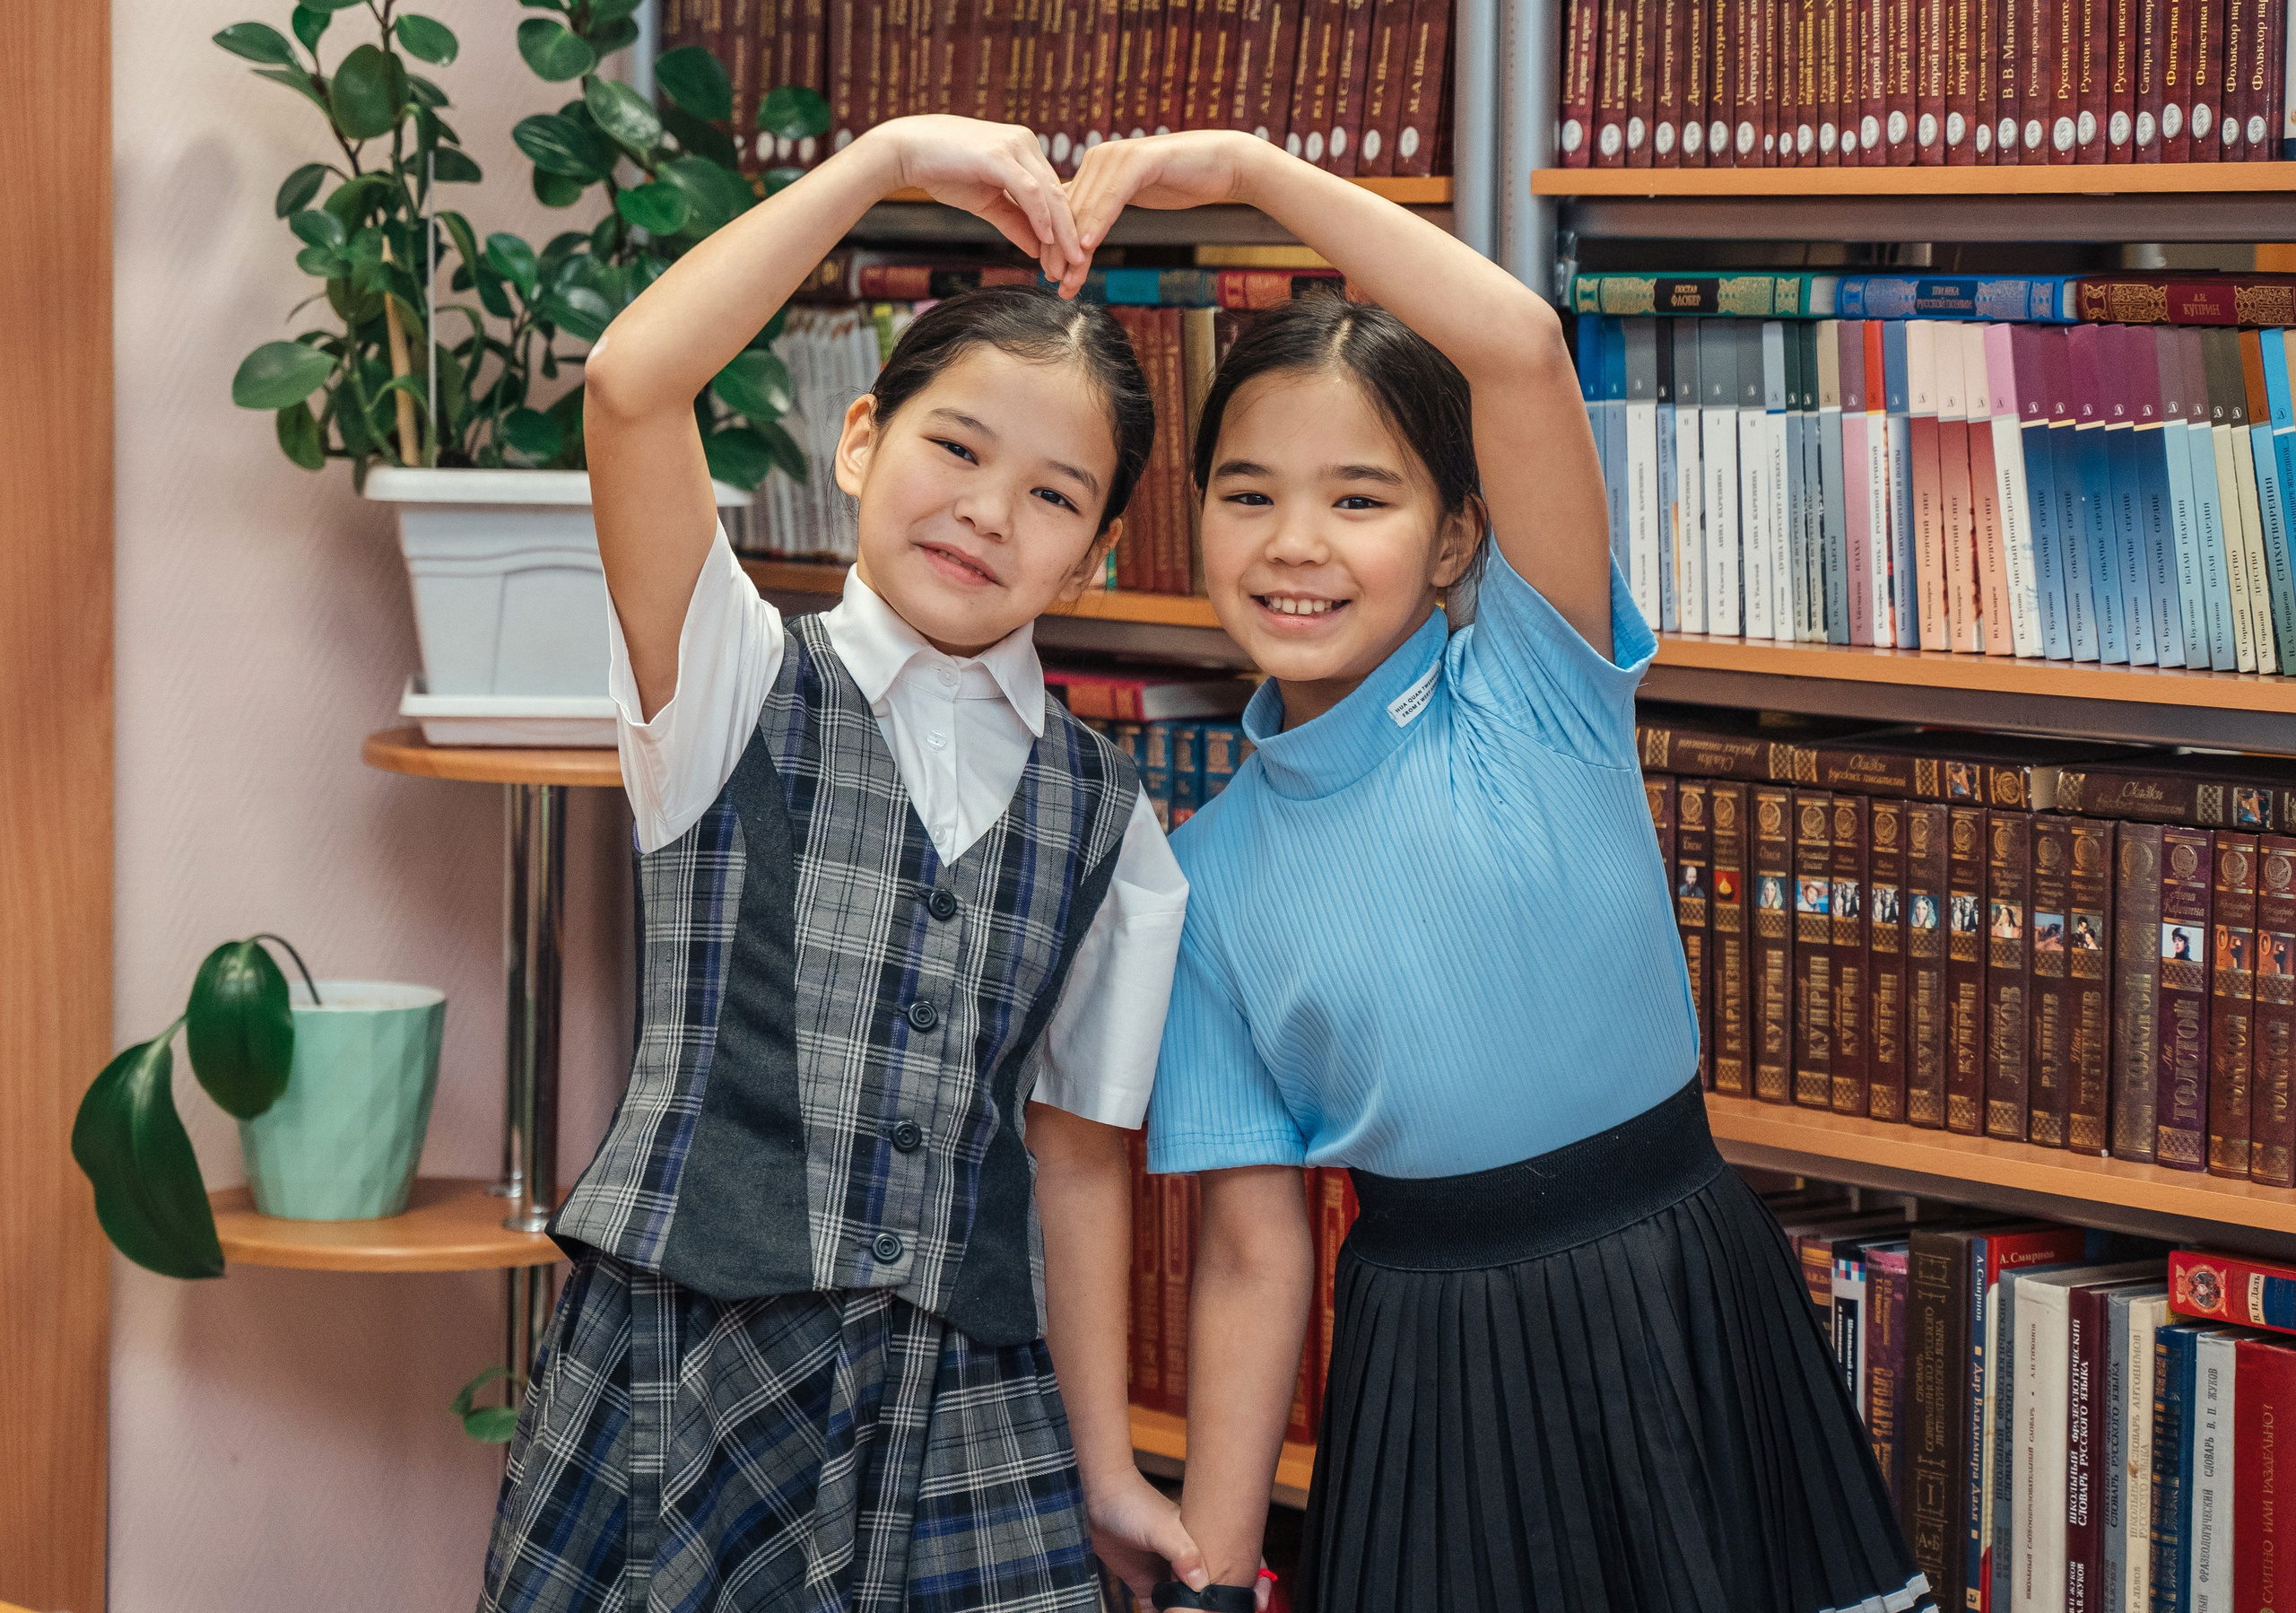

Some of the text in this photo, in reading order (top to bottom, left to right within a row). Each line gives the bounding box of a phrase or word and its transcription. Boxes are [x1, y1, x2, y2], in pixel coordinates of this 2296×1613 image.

[1583, 6, 1592, 40] прозе
[1617, 10, 1629, 99] лирике прозе
[1688, 8, 1701, 106] Древнерусская
[1746, 16, 1760, 105] Литературные
[1861, 11, 1869, 47] проза
[1918, 7, 1928, 97] Русская проза
[1948, 5, 1956, 41] проза
[2028, 26, 2040, 97] Русская проза
[2166, 6, 2179, 86] Фантастика
[2196, 5, 2208, 86] Фантастика
[2226, 23, 2241, 92] Фольклор
[2252, 22, 2267, 91] Фольклор
[1601, 33, 1613, 109] Гражданская
[1631, 24, 1645, 102] Драматургия
[1660, 28, 1674, 107] Драматургия
[1714, 25, 1726, 105] Литература
[1765, 57, 1774, 100] Русская
[1782, 67, 1791, 106] Русская
[1804, 67, 1814, 104] первой
[1820, 57, 1829, 102] Русская
[1827, 65, 1838, 102] второй
[1843, 55, 1855, 103] Русская
[1870, 56, 1883, 99] первой
[1887, 44, 1896, 94] Русская
[1897, 51, 1910, 94] второй
[1928, 53, 1942, 97] второй
[1956, 51, 1970, 95] второй
[1978, 31, 1988, 101] Русская проза
[2002, 63, 2014, 99] В. В.
[2057, 47, 2071, 99] Русские
[2079, 40, 2092, 92] Русские
[2113, 40, 2126, 93] Русские
[2140, 48, 2153, 94] Сатира
[2183, 303, 2221, 317] КУПРИН
[1853, 538, 1861, 571] ПЛАХА
[1896, 490, 1905, 557] СТИХОТВОРЕНИЯ
[1921, 491, 1933, 620] Бондарев ГОРЯЧИЙ СНЕГ
[1950, 495, 1963, 624] Бондарев ГОРЯЧИЙ СНЕГ
[1983, 496, 1999, 625] Бондарев ГОРЯЧИЙ СНЕГ
[2003, 469, 2021, 587] ЧИСТЫЙ ПОНЕДЕЛЬНИК
[2037, 489, 2057, 630] Булгаков СОБАЧЬЕ СЕРДЦЕ
[2064, 490, 2083, 632] Булгаков СОБАЧЬЕ СЕРДЦЕ
[2265, 476, 2293, 632] Некрасов СТИХОТВОРЕНИЯ
[2093, 493, 2114, 634] Булгаков СОБАЧЬЕ СЕРДЦЕ
[2122, 493, 2142, 636] Булгаков СОБАЧЬЕ СЕРДЦЕ
[2151, 494, 2170, 638] Булгаков СОБАЧЬЕ СЕРДЦЕ
[2178, 500, 2196, 639] Булгаков БЕЛАЯ ГВАРДИЯ
[2203, 501, 2222, 641] Булгаков БЕЛАЯ ГВАРДИЯ
[2231, 549, 2248, 644] Горький ДЕТСТВО
[2250, 551, 2268, 646] Горький ДЕТСТВО
[1395, 702, 1408, 714] HUA
[1407, 689, 1423, 704] QUAN
[1402, 704, 1418, 719] FROM
[2122, 780, 2165, 800] Сказки
[2163, 898, 2205, 917] Каренина
[2170, 886, 2196, 902] Анна
[1725, 939, 1740, 1051] КАРАМЗИН
[1765, 949, 1784, 1053] КУПРИН
[1809, 955, 1829, 1059] КУПРИН
[1841, 966, 1858, 1057] КУПРИН
[1879, 972, 1897, 1063] КУПРИН
[1918, 970, 1937, 1076] КУПРИН
[1959, 982, 1976, 1074] КУПРИН
[2125, 972, 2152, 1092] ТОЛСТОЙ
[1999, 986, 2021, 1084] ЛЕСКОВ
[2081, 990, 2101, 1105] ТУРГЕНЕВ
[2161, 1043, 2174, 1071] Лев
[2172, 998, 2199, 1120] ТОЛСТОЙ
[1974, 1269, 1985, 1321] Смирнов
[2010, 1251, 2057, 1263] Смирнов
[2250, 1275, 2261, 1300] Даль
[1871, 1366, 1894, 1437] СЛОВАРЬ
[1915, 1353, 1924, 1402] СЛОВАРЬ
[1925, 1306, 1934, 1452] СОВРЕМЕННОГО РУССКОГО
[1935, 1319, 1944, 1448] ЛИТЕРАТУРНОГО ЯЗЫКА
[2131, 1332, 2142, 1462] СЛОВАРЬ АНТОНИМОВ
[1970, 1362, 1985, 1521] Дар Владимира Даля
[2005, 1339, 2014, 1503] СЛОВАРЬ РУССКОГО ЯЗЫКА
[2068, 1318, 2081, 1524] ШКОЛЬНЫЙ ФРАЗЕОЛОГИЧЕСКИЙ
[2077, 1360, 2090, 1526] СЛОВАРЬ РУССКОГО ЯЗЫКА
[2109, 1360, 2120, 1528] СЛОВАРЬ РУССКОГО ЯЗЫКА
[1996, 1427, 2005, 1501] ШКОЛЬНЫЙ
[2138, 1443, 2150, 1540] РУССКОГО ЯЗЫКА
[2198, 1366, 2218, 1583] ФРАЗЕОЛОГИЧЕСКИЙ СЛОВАРЬ ЖУКОВ
[2261, 1402, 2274, 1604] СЛИТНО ИЛИ РАЗДЕЛЬНО?
[2068, 1560, 2076, 1595] ЖУКОВ
[2133, 1565, 2141, 1598] ЛЬВОВ
